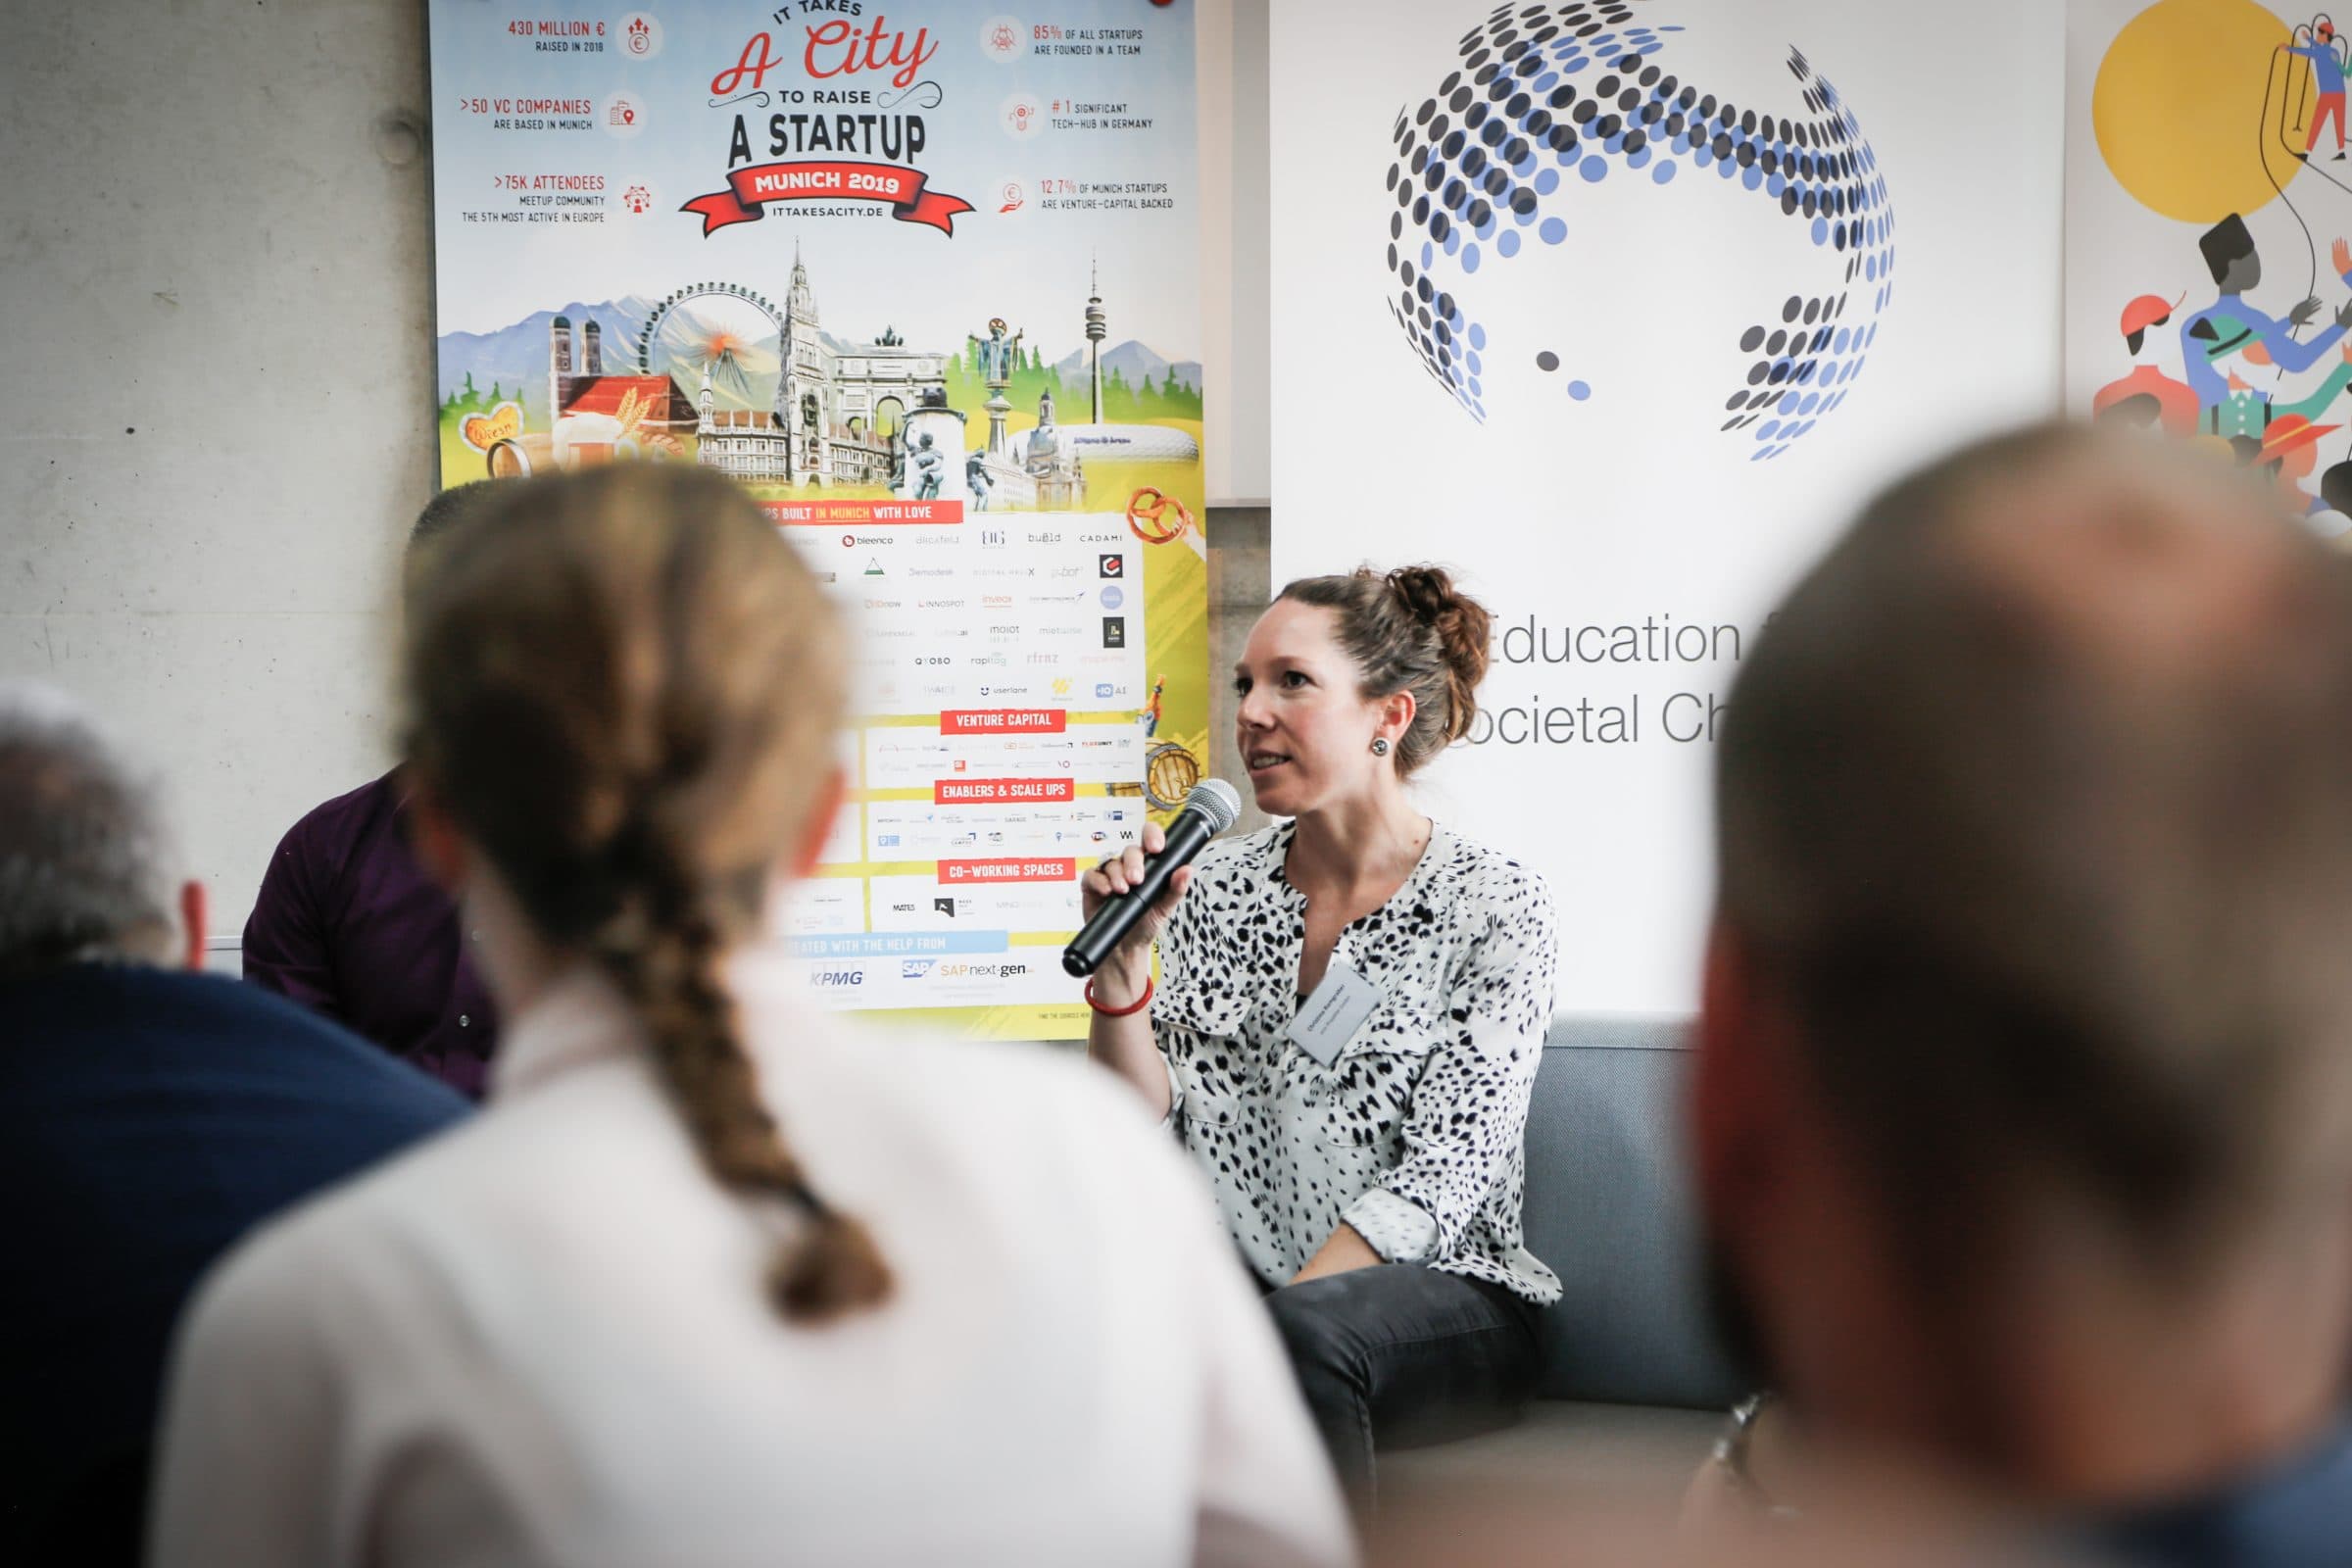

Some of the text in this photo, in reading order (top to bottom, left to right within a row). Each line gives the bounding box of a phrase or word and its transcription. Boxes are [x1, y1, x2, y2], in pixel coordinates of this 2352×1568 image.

[772, 0, 862, 25] IT TAKES
[508, 21, 606, 36] 430 MILLION €
[1034, 24, 1143, 40] 85% OF ALL STARTUPS
[535, 41, 604, 53] RAISED IN 2018
[1034, 45, 1142, 56] ARE FOUNDED IN A TEAM
[710, 16, 939, 95] A City
[779, 90, 871, 104] TO RAISE
[493, 99, 511, 114] VC
[516, 99, 592, 115] COMPANIES
[1074, 104, 1127, 115] SIGNIFICANT
[494, 120, 593, 130] ARE BASED IN MUNICH
[1053, 119, 1153, 129] TECH-HUB IN GERMANY
[728, 113, 926, 170] A STARTUP
[533, 175, 605, 190] ATTENDEES
[755, 172, 900, 194] MUNICH 2019
[1079, 184, 1089, 194] OF
[1092, 184, 1123, 194] MUNICH
[1125, 183, 1168, 194] STARTUPS
[519, 196, 605, 206] MEETUP COMMUNITY
[1042, 199, 1173, 210] ARE VENTURE-CAPITAL BACKED
[463, 212, 605, 222] THE 5TH MOST ACTIVE IN EUROPE
[772, 207, 883, 218] ITTAKESACITY.DE
[783, 507, 811, 519] BUILT
[815, 507, 826, 518] IN
[830, 507, 870, 518] MUNICH
[874, 506, 902, 518] WITH
[906, 506, 932, 518] LOVE
[993, 686, 1027, 695] userlane
[956, 713, 1052, 727] VENTURE CAPITAL
[1466, 694, 1639, 745] ocietal
[943, 784, 1065, 798] ENABLERS & SCALE UPS
[950, 864, 1063, 878] CO-WORKING SPACES
[832, 940, 858, 952] WITH
[864, 940, 883, 951] THE
[888, 939, 912, 951] HELP
[917, 938, 946, 950] FROM
[903, 962, 932, 974] SAP
[812, 971, 862, 985] KPMG
